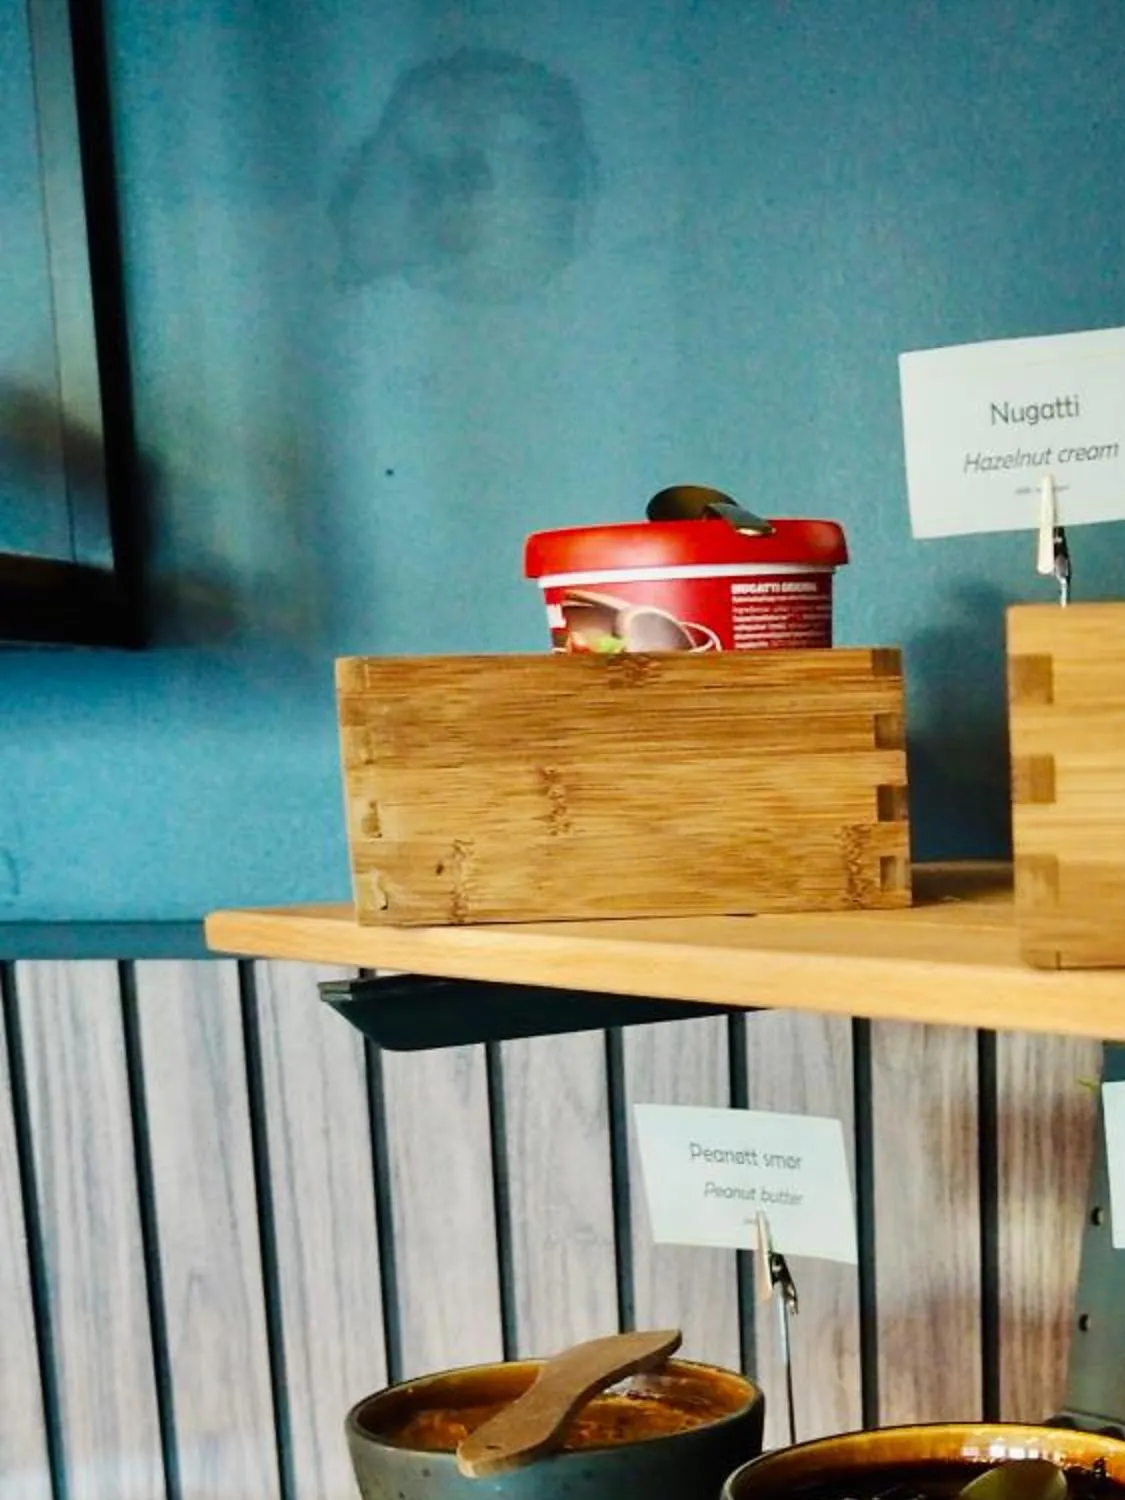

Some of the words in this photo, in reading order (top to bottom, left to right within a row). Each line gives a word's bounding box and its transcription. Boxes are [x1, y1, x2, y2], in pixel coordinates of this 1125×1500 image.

[990, 393, 1080, 426] Nugatti
[963, 446, 1053, 475] Hazelnut
[1058, 441, 1120, 466] cream
[703, 1181, 756, 1202] Peanut
[760, 1186, 804, 1205] butter
